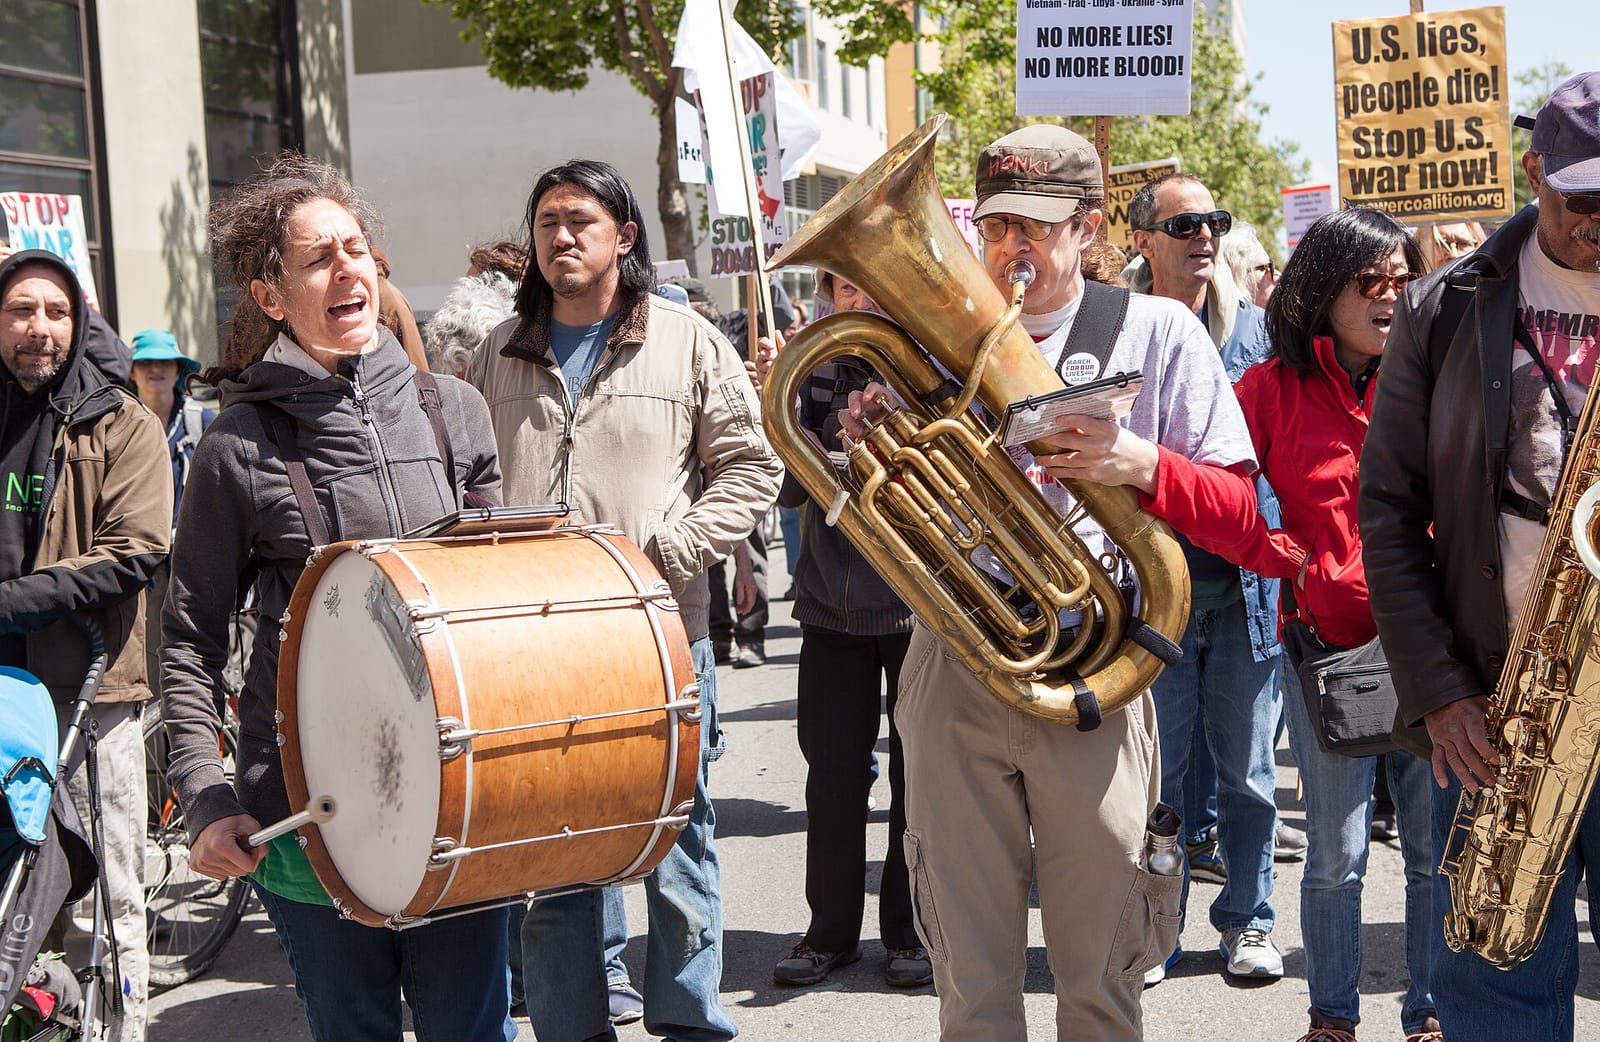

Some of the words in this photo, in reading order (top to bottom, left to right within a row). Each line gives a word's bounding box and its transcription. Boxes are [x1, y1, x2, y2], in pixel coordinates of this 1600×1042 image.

[1026, 0, 1062, 9] Vietnam
[1037, 27, 1063, 48] NO
[1068, 26, 1122, 47] MORE
[1127, 25, 1173, 46] LIES!
[1351, 24, 1409, 64] U.S.
[1416, 21, 1486, 58] lies,
[1025, 57, 1051, 78] NO
[1056, 56, 1110, 78] MORE
[1114, 55, 1184, 77] BLOOD!
[1343, 72, 1439, 119] people
[1447, 65, 1500, 106] die!
[1352, 126, 1426, 159] Stop
[1435, 116, 1493, 153] U.S.
[988, 154, 1049, 179] HONK!
[1348, 163, 1410, 195] war
[1419, 151, 1499, 190] now!
[4, 195, 69, 227] STOP
[21, 229, 75, 261] WAR
[712, 216, 755, 245] STO
